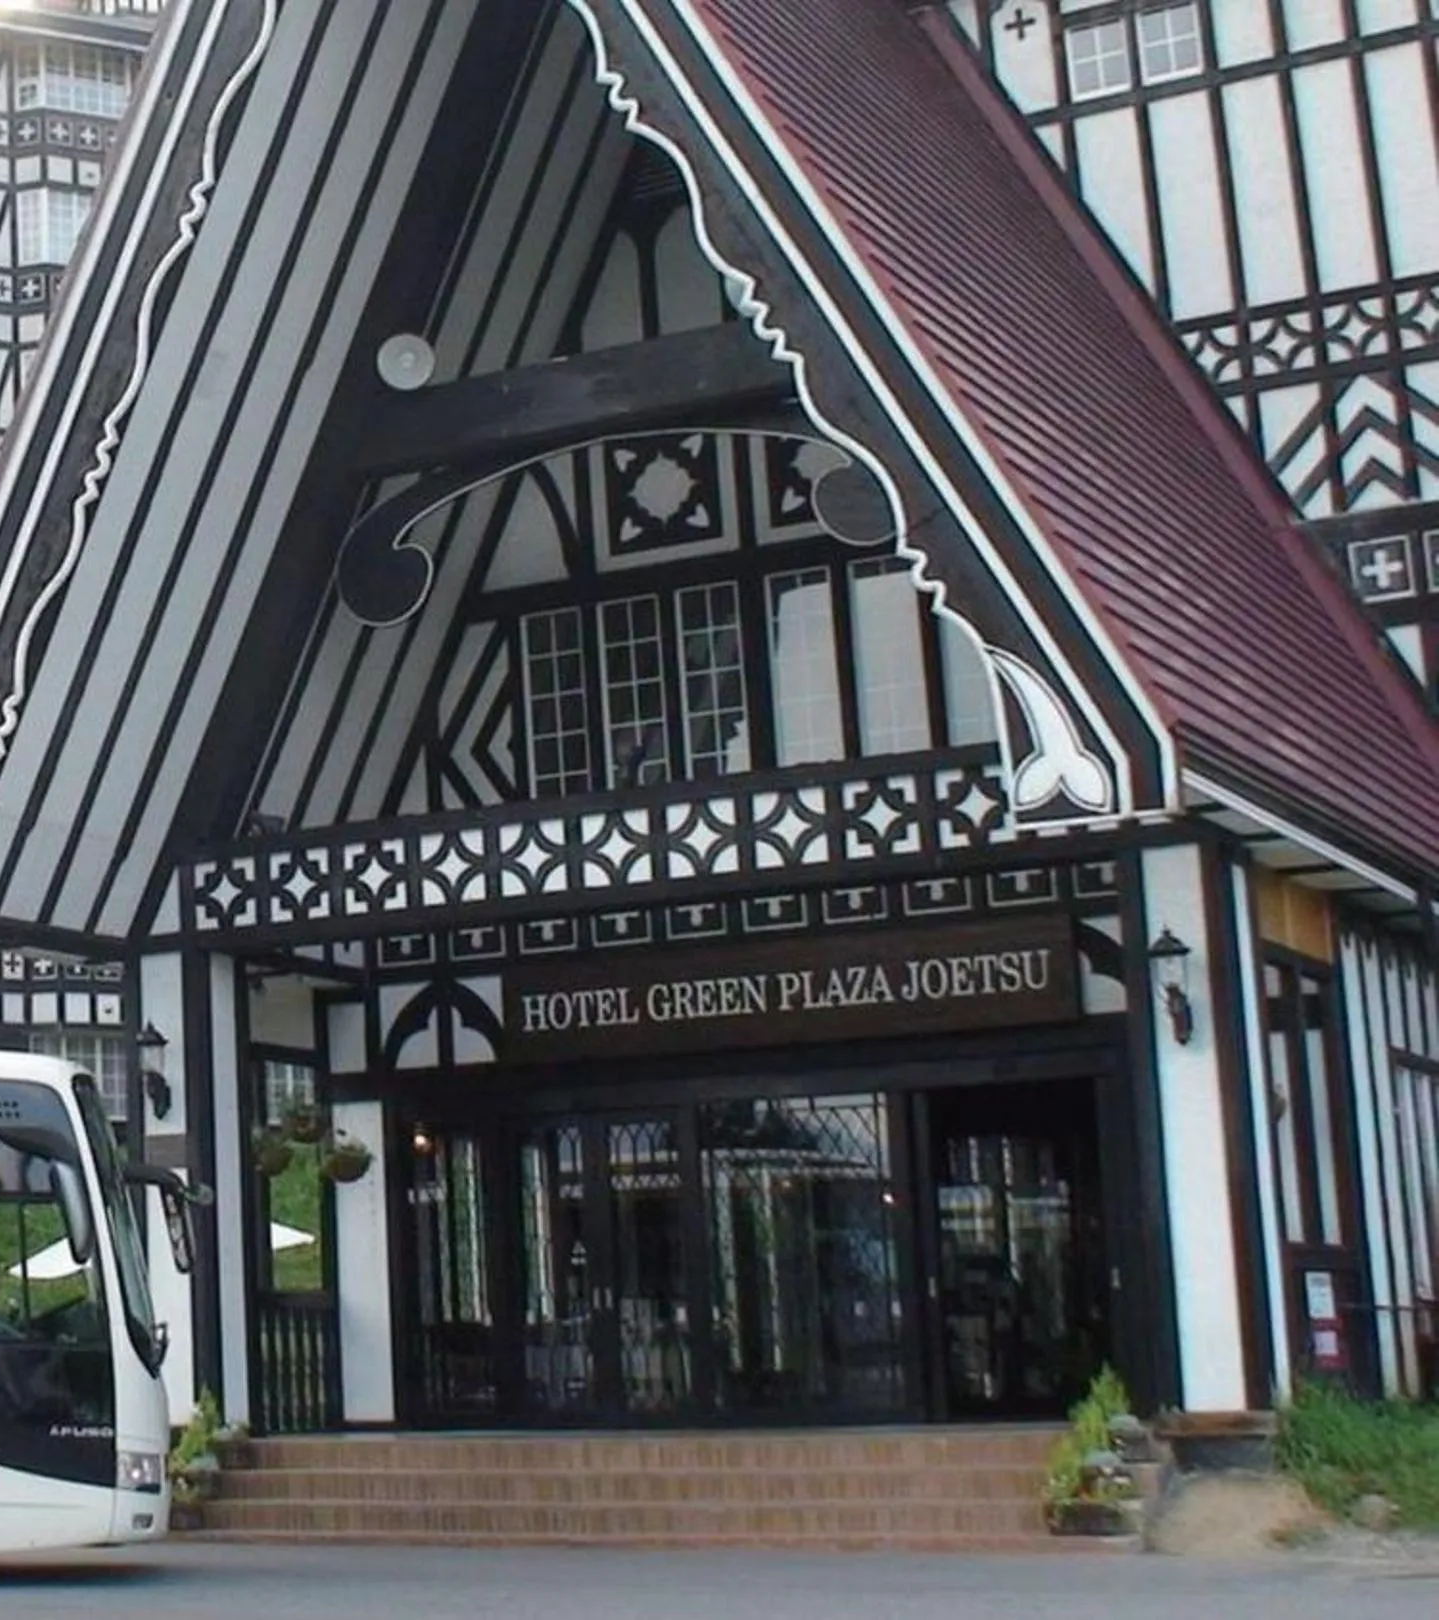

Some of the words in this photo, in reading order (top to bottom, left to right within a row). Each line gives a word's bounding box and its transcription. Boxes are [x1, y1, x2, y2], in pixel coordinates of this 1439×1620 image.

[522, 986, 640, 1031] HOTEL
[647, 974, 769, 1021] GREEN
[776, 964, 895, 1011] PLAZA
[901, 949, 1051, 1001] JOETSU
